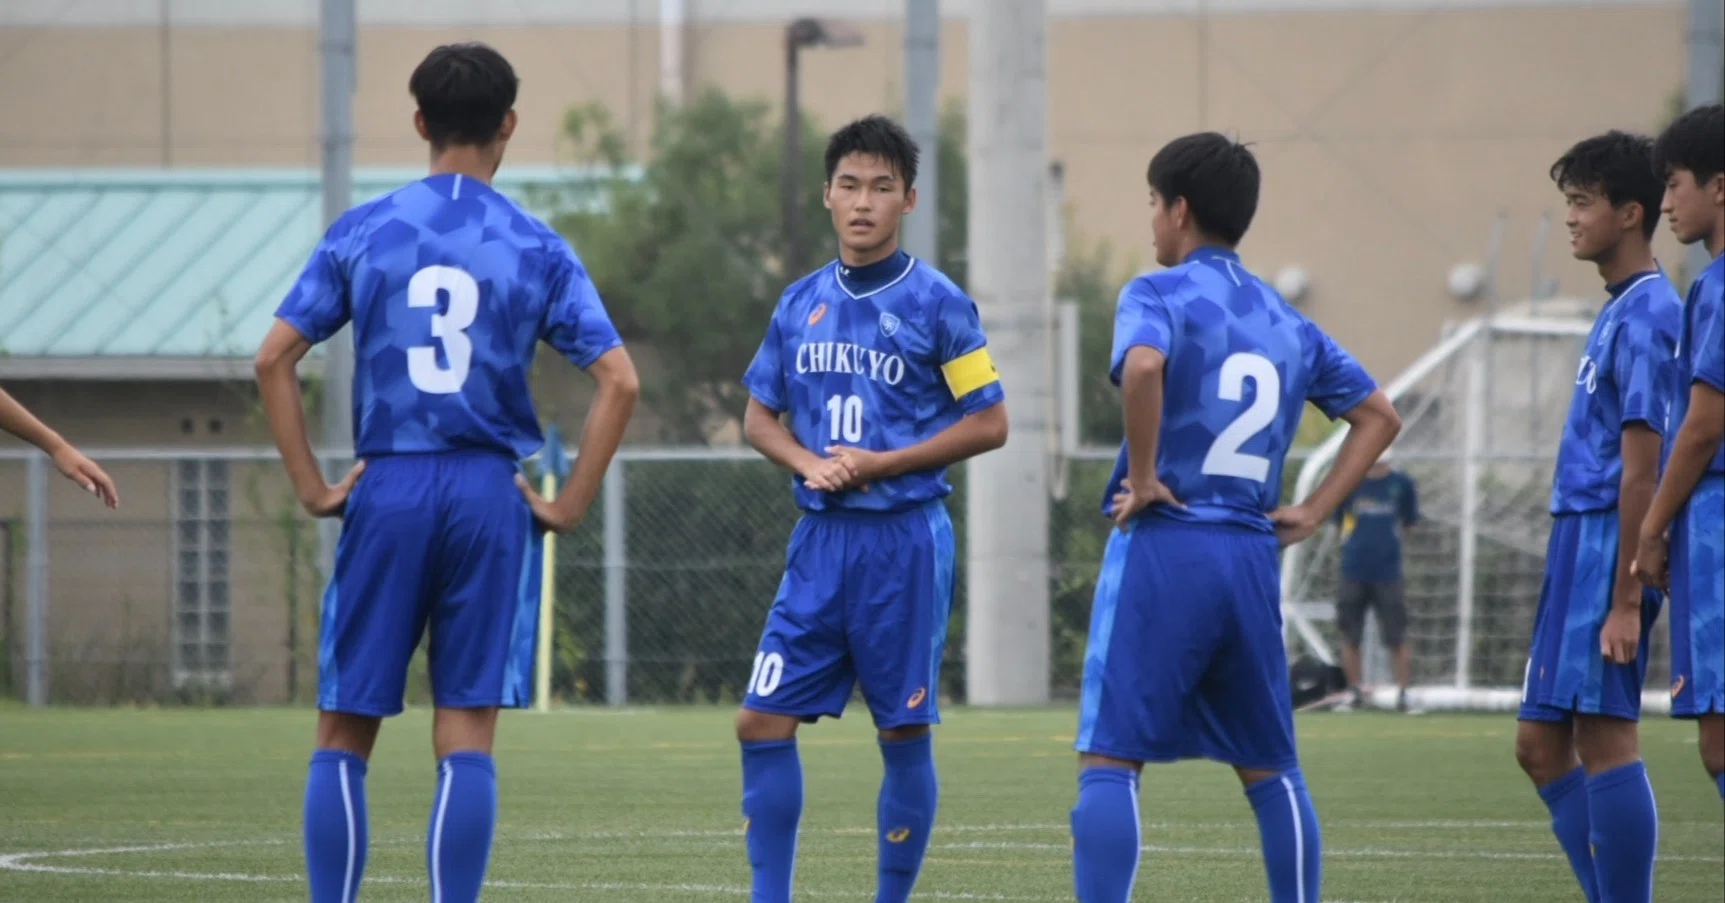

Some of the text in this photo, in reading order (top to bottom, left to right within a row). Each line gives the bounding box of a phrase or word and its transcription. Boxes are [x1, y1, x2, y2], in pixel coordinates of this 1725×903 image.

[407, 264, 479, 394] 3
[796, 341, 905, 386] CHIKUYO
[827, 394, 863, 443] 10
[1201, 352, 1280, 483] 2
[747, 651, 784, 697] 10
